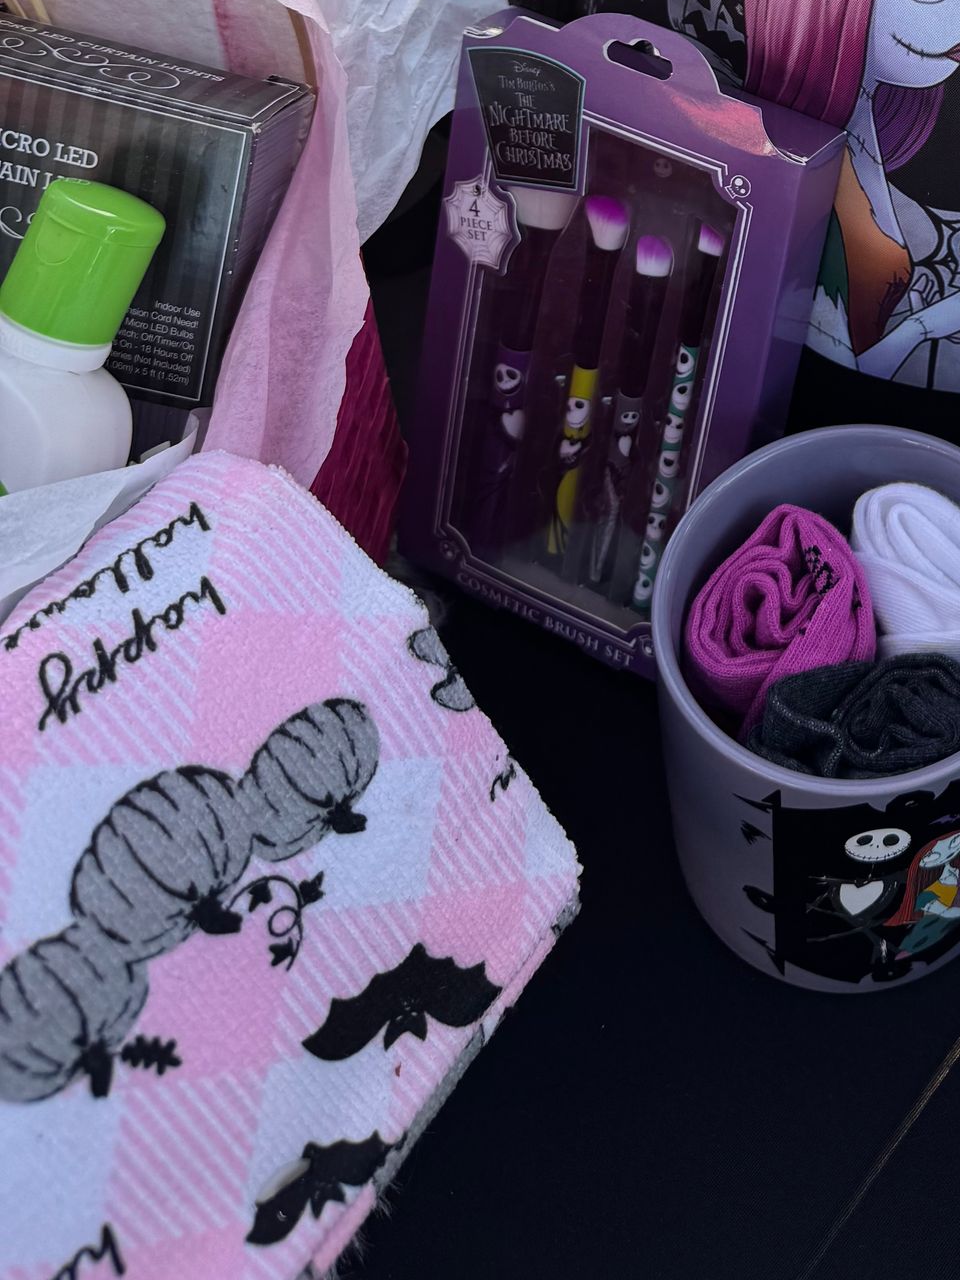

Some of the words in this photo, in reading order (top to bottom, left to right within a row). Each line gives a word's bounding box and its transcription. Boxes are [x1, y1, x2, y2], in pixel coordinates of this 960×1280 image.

[38, 29, 76, 43] LED
[77, 40, 161, 65] CURTAIN
[158, 62, 225, 83] LIGHTS
[514, 91, 537, 109] THE
[489, 100, 573, 134] NIGHTMARE
[0, 128, 50, 157] CRO
[53, 142, 99, 169] LED
[510, 127, 560, 151] BEFORE
[496, 140, 572, 172] CHRISTMAS
[0, 161, 41, 187] AIN
[468, 199, 480, 217] 4
[460, 217, 493, 231] PIECE
[467, 229, 487, 241] SET
[128, 307, 149, 317] nsion
[151, 311, 172, 323] Cord
[155, 300, 182, 314] Indoor
[184, 307, 201, 318] Use
[125, 317, 149, 330] Micro
[150, 323, 168, 334] LED
[170, 327, 194, 340] Bulbs
[141, 344, 152, 354] 18
[153, 347, 178, 360] Hours
[180, 352, 194, 363] Off
[153, 358, 191, 375] Included)
[456, 571, 541, 622] COSMETIC
[545, 616, 599, 651] BRUSH
[604, 644, 635, 667] SET
[38, 575, 227, 732] happy
